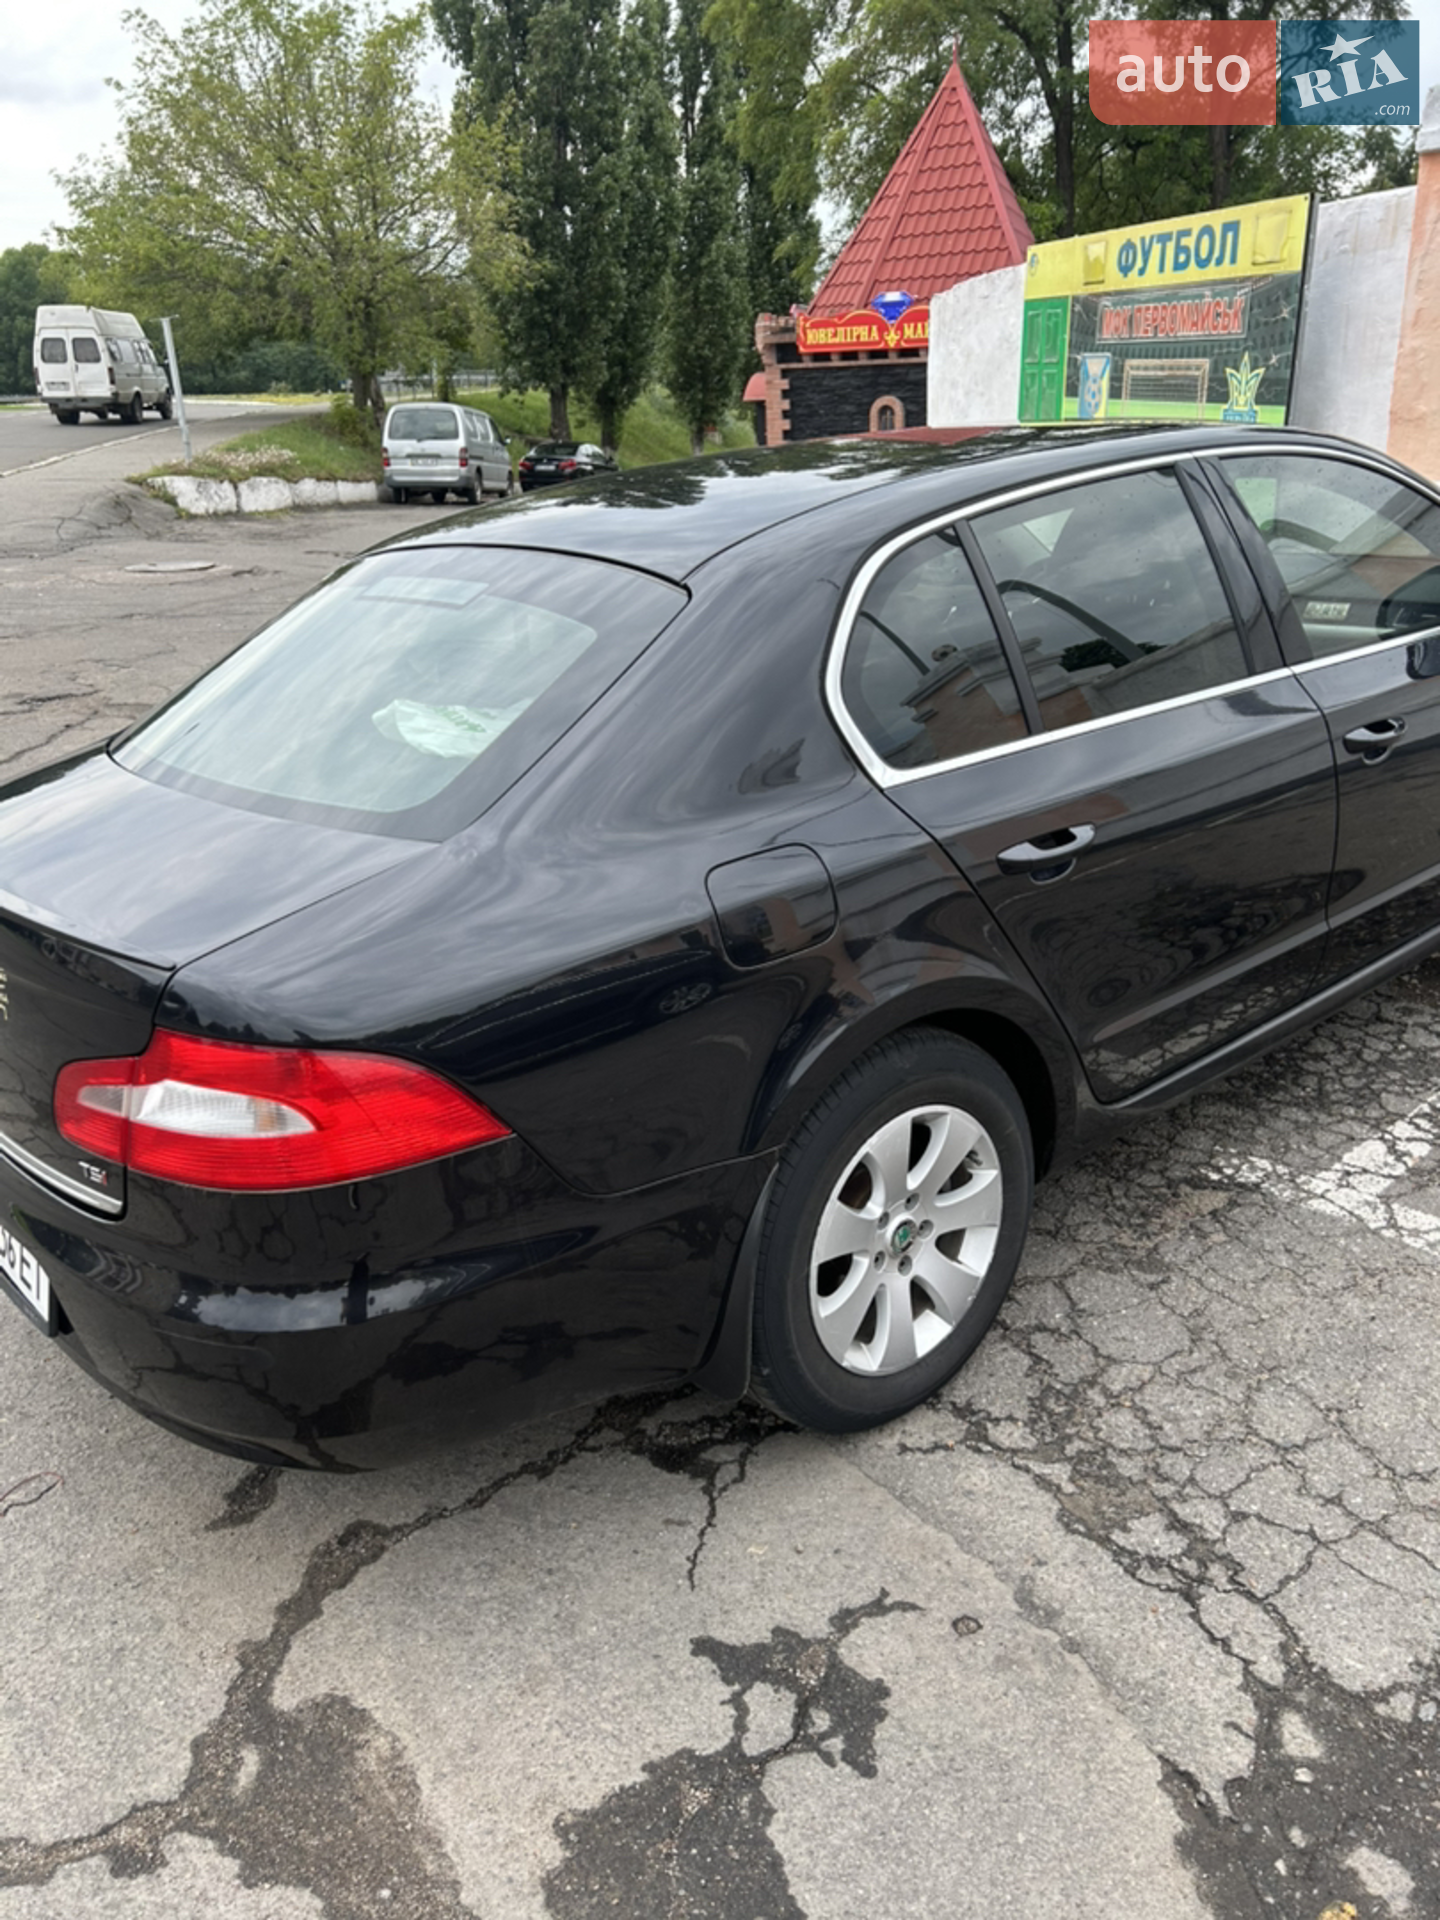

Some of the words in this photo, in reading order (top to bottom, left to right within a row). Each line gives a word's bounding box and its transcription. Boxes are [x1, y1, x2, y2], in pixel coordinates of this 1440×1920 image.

[1116, 219, 1241, 278] ФУТБОЛ
[806, 325, 879, 345] ЮВЕЛІРНА
[1132, 292, 1245, 337] ПЕРВОМАЙСЬК
